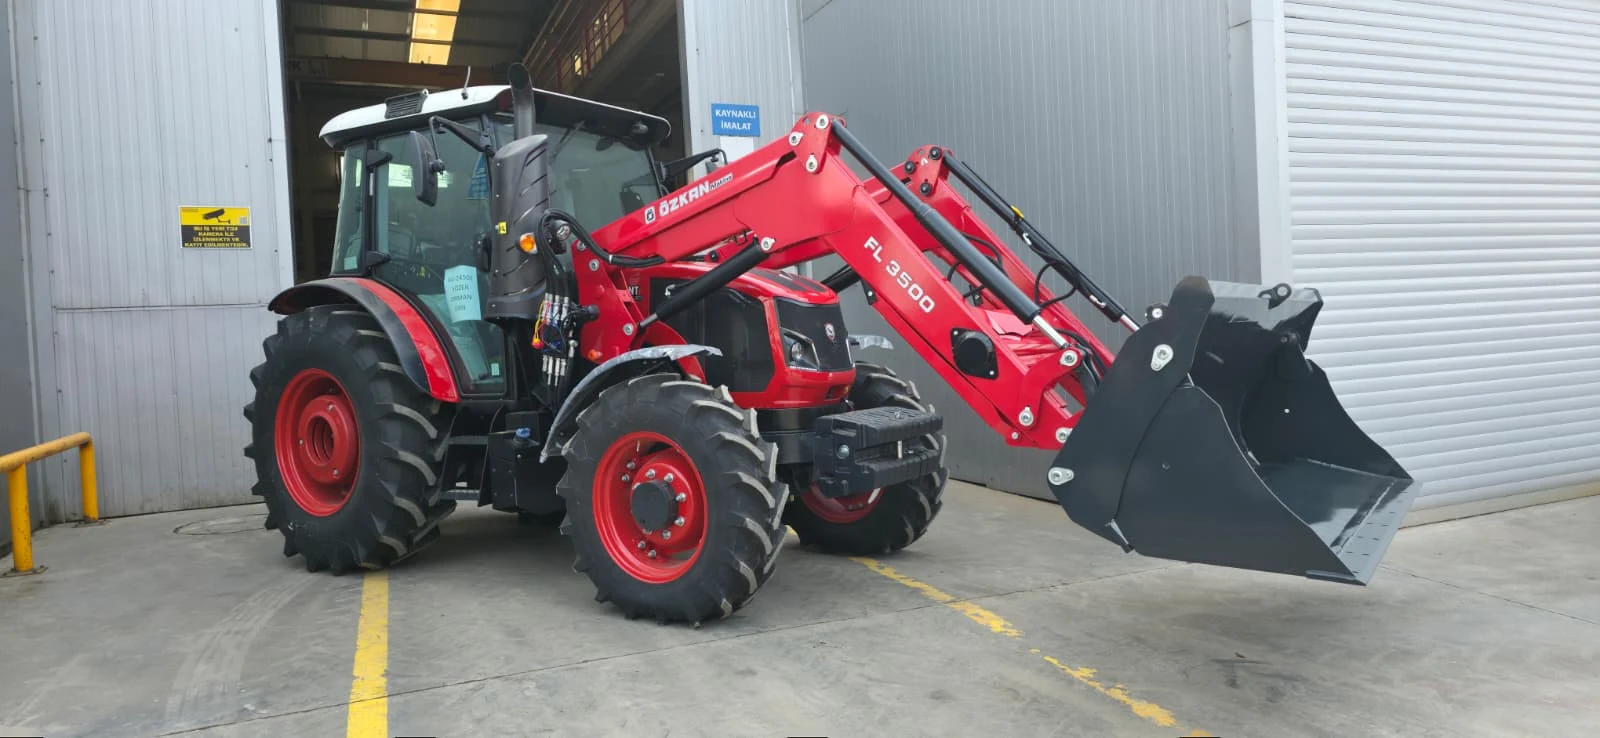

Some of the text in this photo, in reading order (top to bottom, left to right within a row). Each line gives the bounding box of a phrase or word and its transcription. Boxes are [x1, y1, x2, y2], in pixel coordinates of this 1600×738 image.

[715, 109, 756, 119] KAYNAKLI
[721, 120, 752, 130] İMALAT
[659, 181, 710, 217] ÖZKAN
[864, 236, 936, 313] FL 3500
